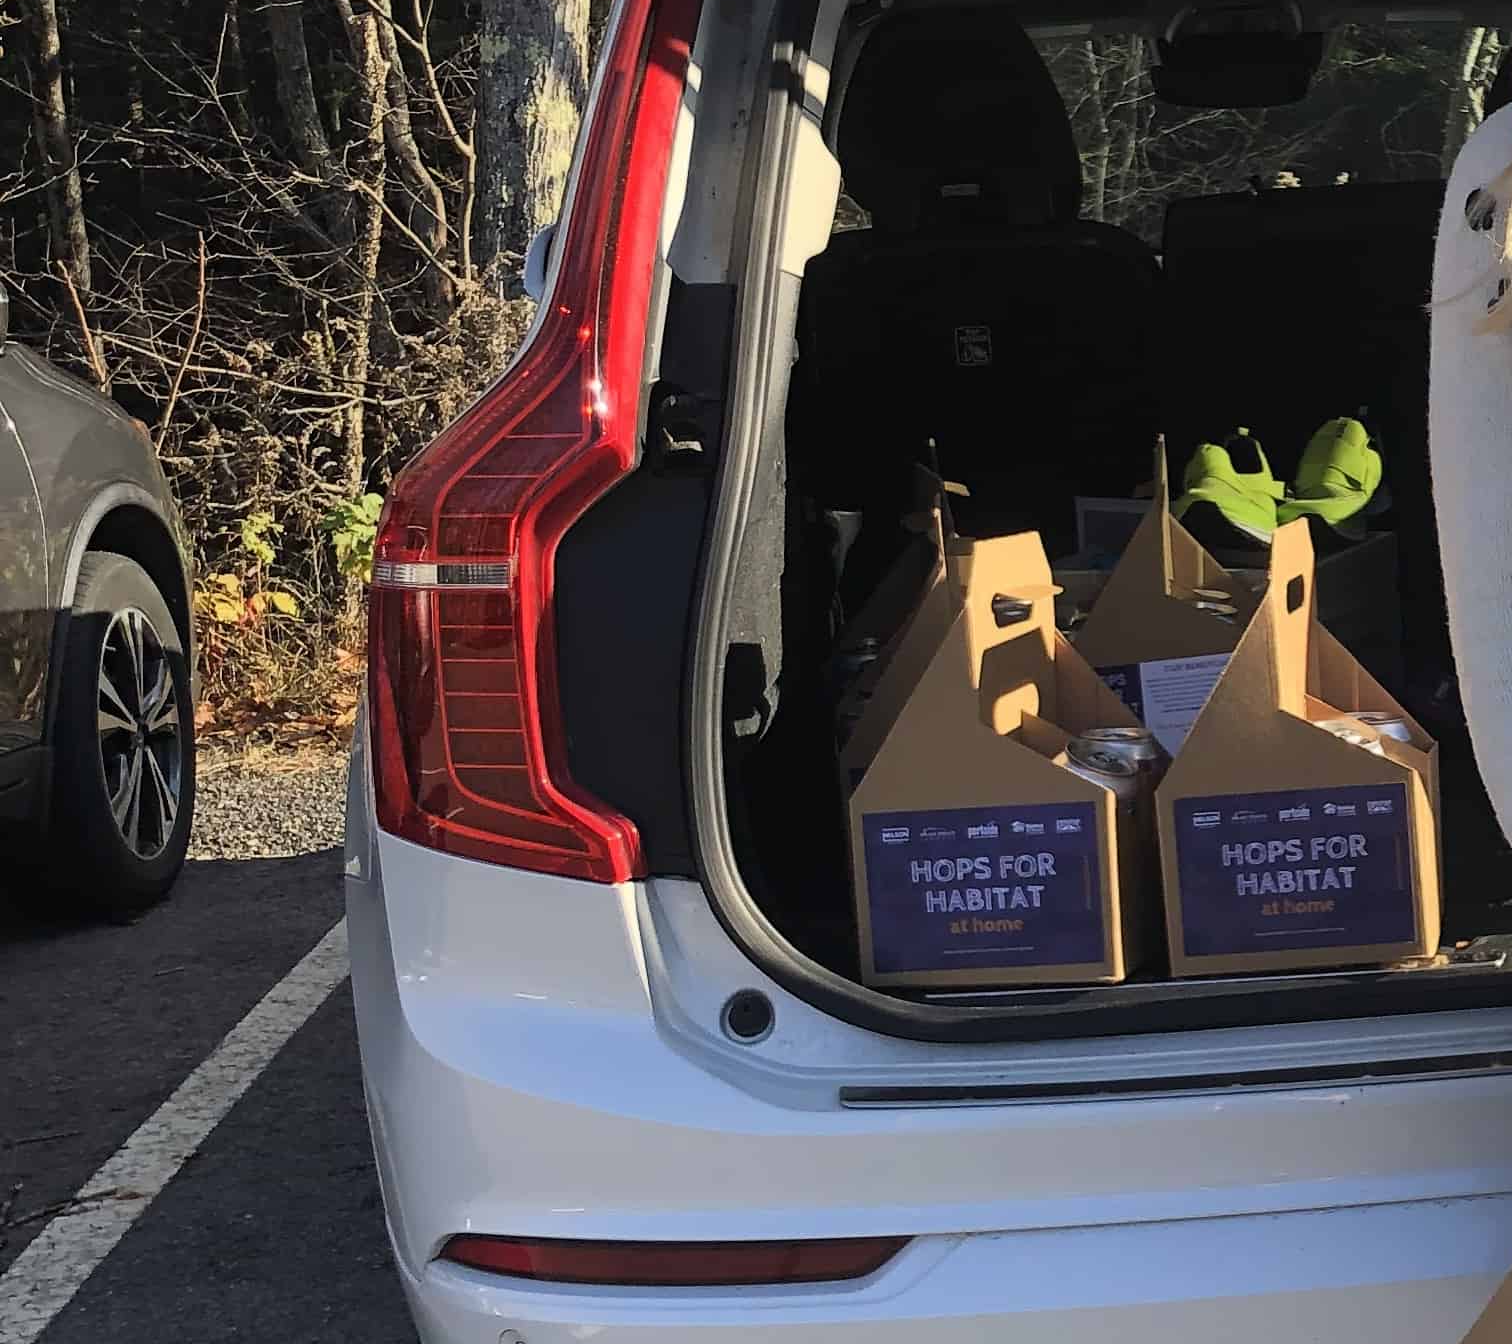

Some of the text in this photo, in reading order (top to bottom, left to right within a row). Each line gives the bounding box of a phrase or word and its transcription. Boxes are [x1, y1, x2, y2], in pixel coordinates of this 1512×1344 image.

[1222, 838, 1304, 867] HOPS
[1310, 834, 1369, 861] FOR
[910, 852, 1057, 883] HOPS FOR
[1236, 866, 1357, 896] HABITAT
[926, 885, 1045, 913] HABITAT
[1261, 898, 1336, 916] at home
[951, 917, 1024, 934] at home
